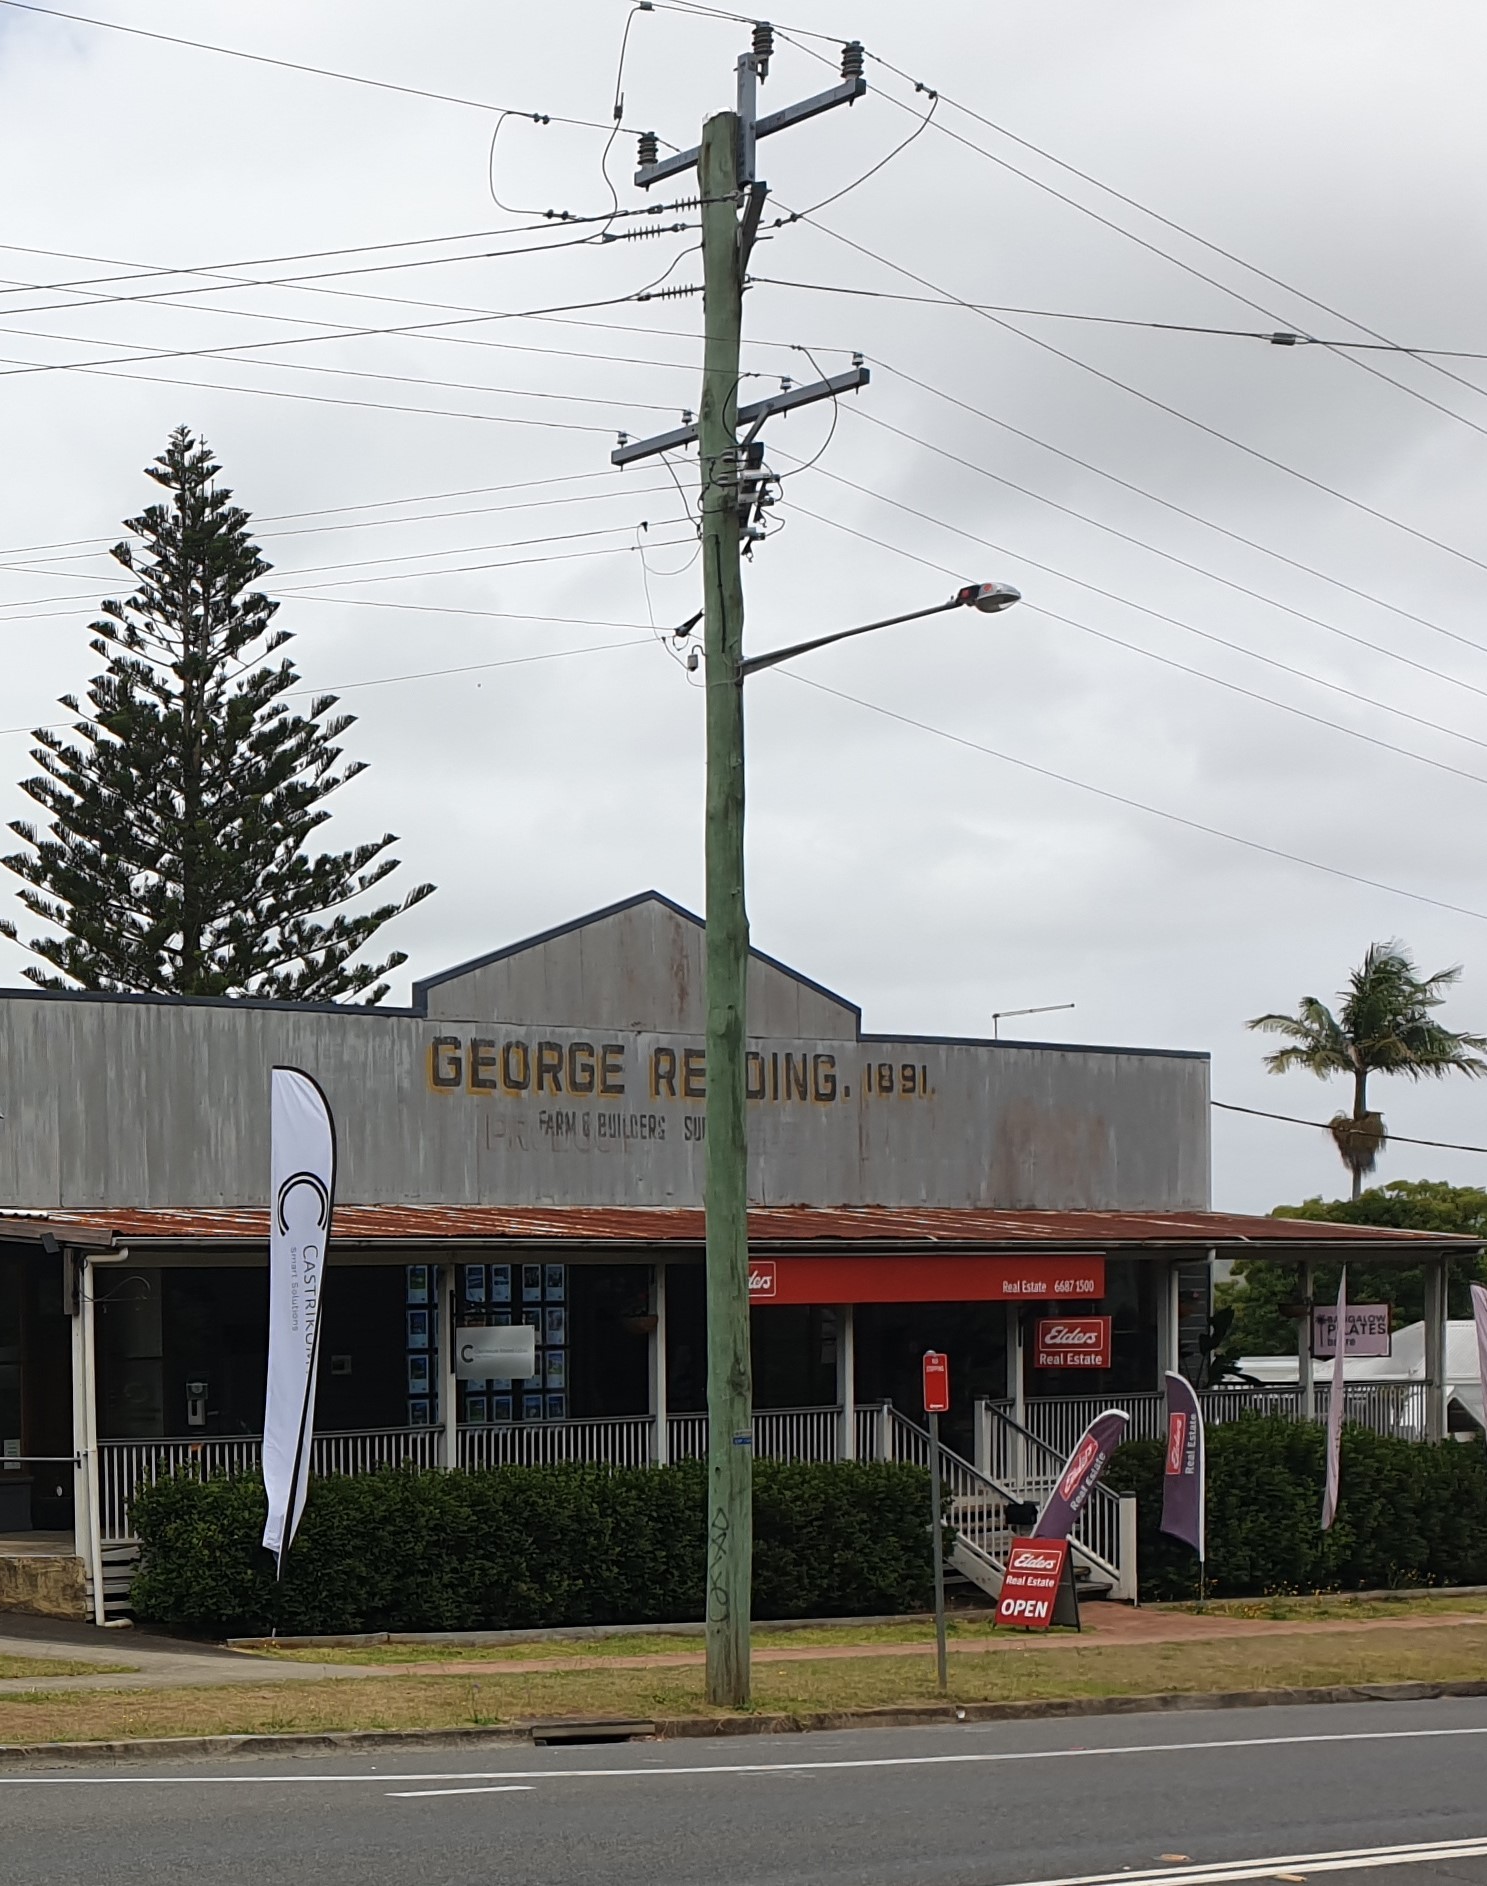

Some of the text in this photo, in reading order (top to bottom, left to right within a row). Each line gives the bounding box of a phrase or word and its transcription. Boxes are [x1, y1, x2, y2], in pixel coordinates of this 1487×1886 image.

[428, 1036, 936, 1102] GEORGE REDING. 1891.
[539, 1110, 577, 1138] FARM
[597, 1112, 666, 1141] BUILDERS
[748, 1269, 773, 1289] ders
[1002, 1280, 1095, 1293] Real Estate 6687 1500
[291, 1282, 300, 1332] Solutions
[1327, 1314, 1386, 1323] BGALOW
[1044, 1326, 1098, 1344] Elders
[1327, 1323, 1387, 1335] PATES
[1039, 1352, 1103, 1365] Real Estate
[1184, 1413, 1197, 1475] Real Estate
[1070, 1451, 1106, 1512] Real Estate
[1013, 1553, 1057, 1569] Elders
[1005, 1575, 1055, 1588] Real Estate
[1001, 1598, 1049, 1618] OPEN
